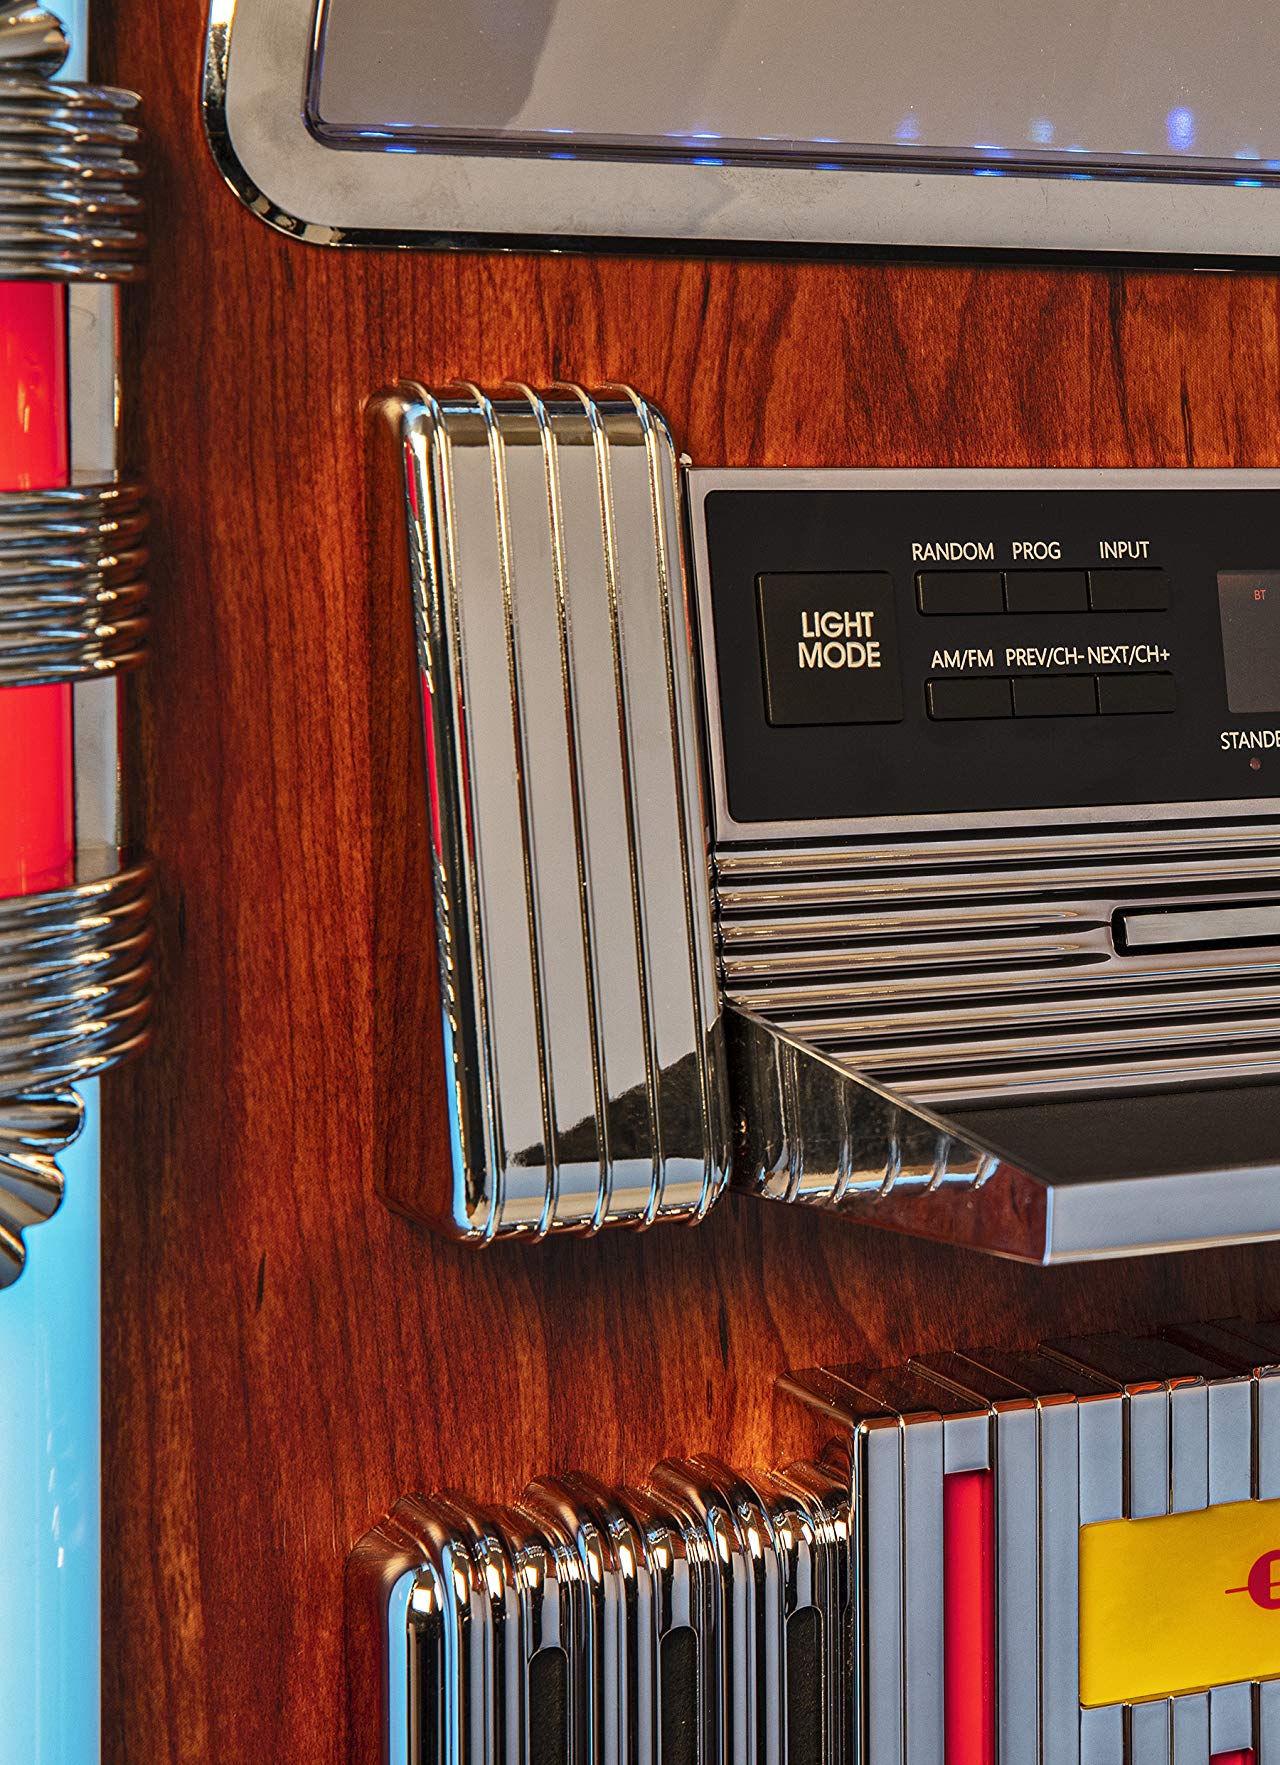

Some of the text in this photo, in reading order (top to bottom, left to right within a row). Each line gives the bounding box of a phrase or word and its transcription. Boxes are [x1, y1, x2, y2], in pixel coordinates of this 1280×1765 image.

[911, 540, 1150, 561] RANDOM PROG INPUT
[1253, 589, 1267, 601] BT
[800, 610, 875, 639] LIGHT
[798, 640, 882, 669] MODE
[931, 644, 1171, 670] AM/FM PREV/CH- NEXT/CH+
